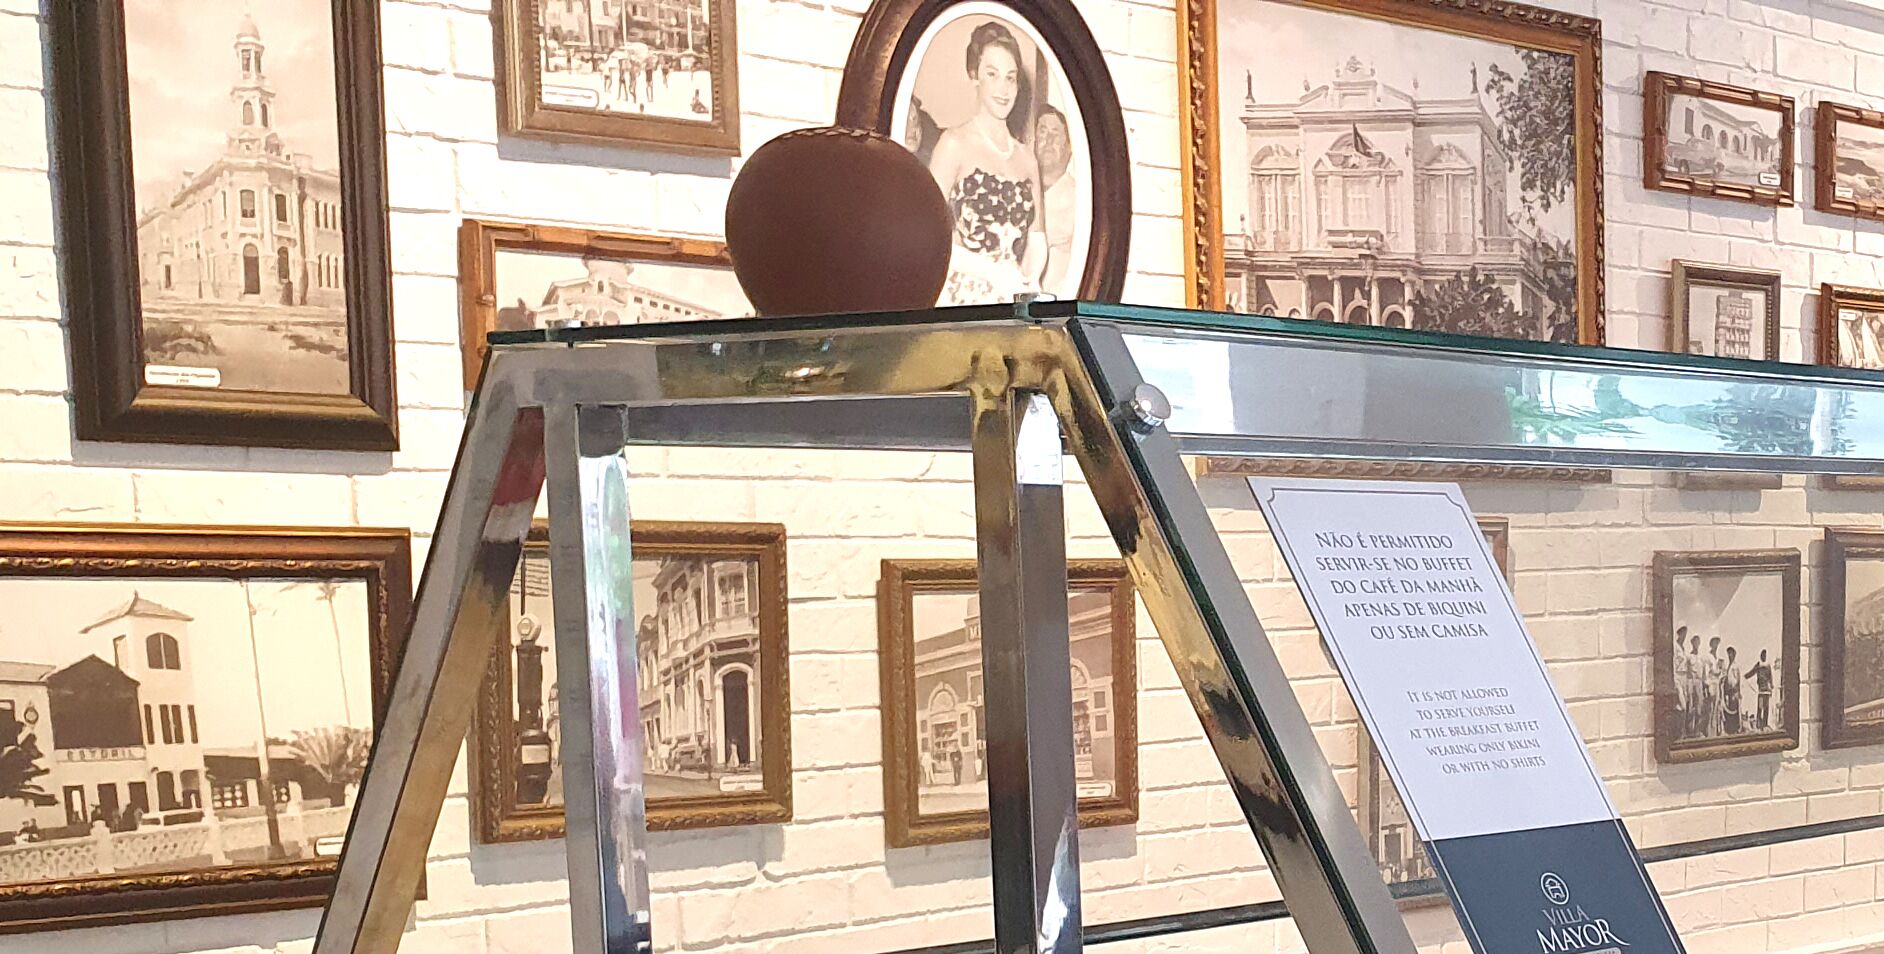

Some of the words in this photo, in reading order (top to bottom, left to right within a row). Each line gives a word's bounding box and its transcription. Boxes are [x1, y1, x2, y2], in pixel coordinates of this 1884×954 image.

[1314, 532, 1353, 548] NÃO
[1357, 532, 1368, 548] É
[1369, 534, 1453, 549] PERMITIDO
[1315, 557, 1391, 571] SERVIR-SE
[1393, 557, 1418, 571] NO
[1422, 557, 1473, 571] BUFFET
[1330, 580, 1356, 594] DO
[1360, 577, 1398, 594] CAFÉ
[1400, 579, 1425, 593] DA
[1426, 577, 1483, 593] MANHÃ
[1344, 602, 1400, 617] APENAS
[1403, 602, 1426, 616] DE
[1427, 601, 1487, 617] BIQUINI
[1370, 626, 1395, 639] OU
[1397, 625, 1430, 639] SEM
[1432, 623, 1488, 638] CAMISA
[1407, 690, 1420, 703] IT
[1421, 690, 1433, 702] IS
[1434, 690, 1457, 701] NOT
[1461, 687, 1508, 700] ALLOWED
[1416, 709, 1433, 721] TO
[1434, 707, 1465, 720] SERVE
[1466, 704, 1515, 718] YOURSELF
[1409, 729, 1423, 740] AT
[1423, 727, 1447, 739] THE
[1448, 723, 1502, 737] BREAKFAST
[1504, 720, 1540, 733] BUFFET
[1425, 743, 1477, 757] WEARING
[1478, 740, 1506, 754] ONLY
[1507, 738, 1541, 751] BIKINI
[1442, 763, 1460, 775] OR
[1459, 761, 1490, 773] WITH
[1492, 759, 1509, 771] NO
[1511, 756, 1546, 769] SHIRTS
[1541, 904, 1590, 926] VILLA
[1536, 918, 1631, 954] MAYOR
